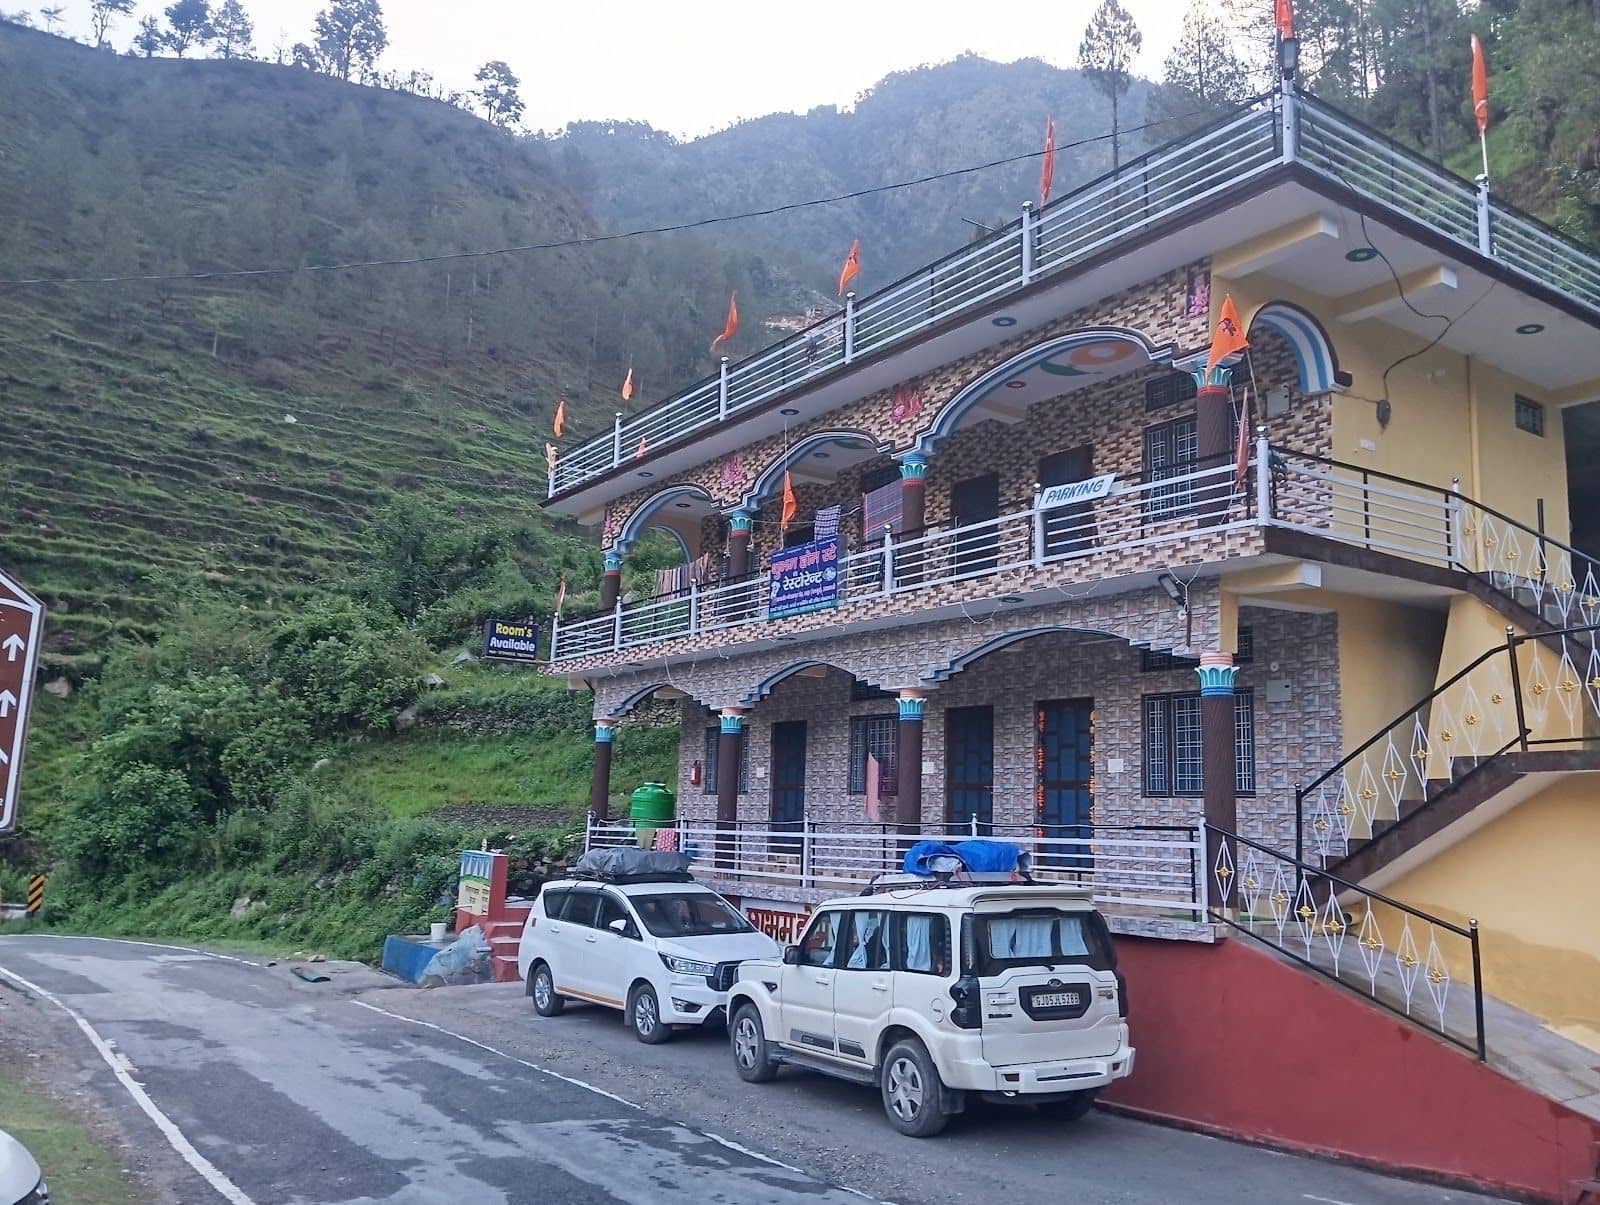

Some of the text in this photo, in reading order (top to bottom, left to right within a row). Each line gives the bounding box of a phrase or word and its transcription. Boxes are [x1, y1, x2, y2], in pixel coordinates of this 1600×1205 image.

[1045, 479, 1105, 504] PARKING
[495, 622, 533, 638] Room's
[490, 636, 536, 652] Available
